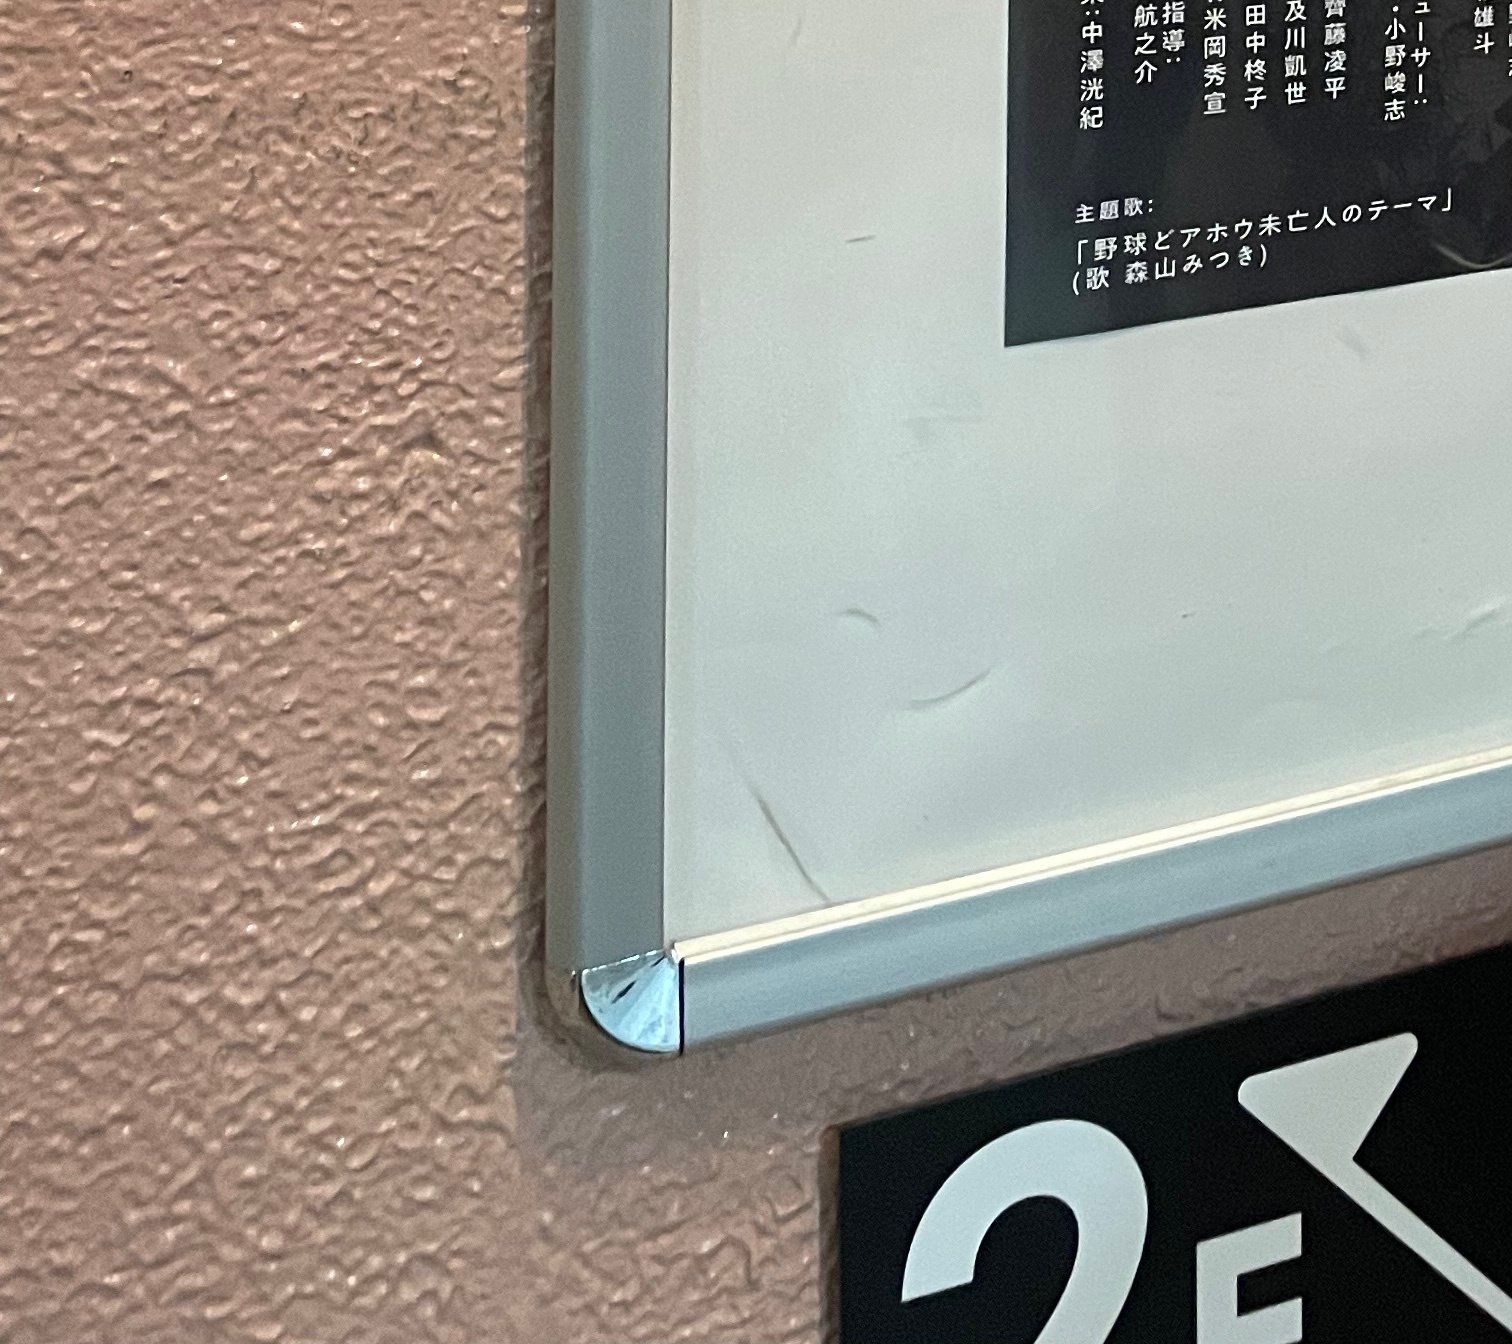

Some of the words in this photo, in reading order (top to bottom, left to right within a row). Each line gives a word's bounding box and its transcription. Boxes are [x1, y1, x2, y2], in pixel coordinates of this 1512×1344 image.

[1076, 187, 1453, 265] 「野球どアホウ未亡人のテーマ」
